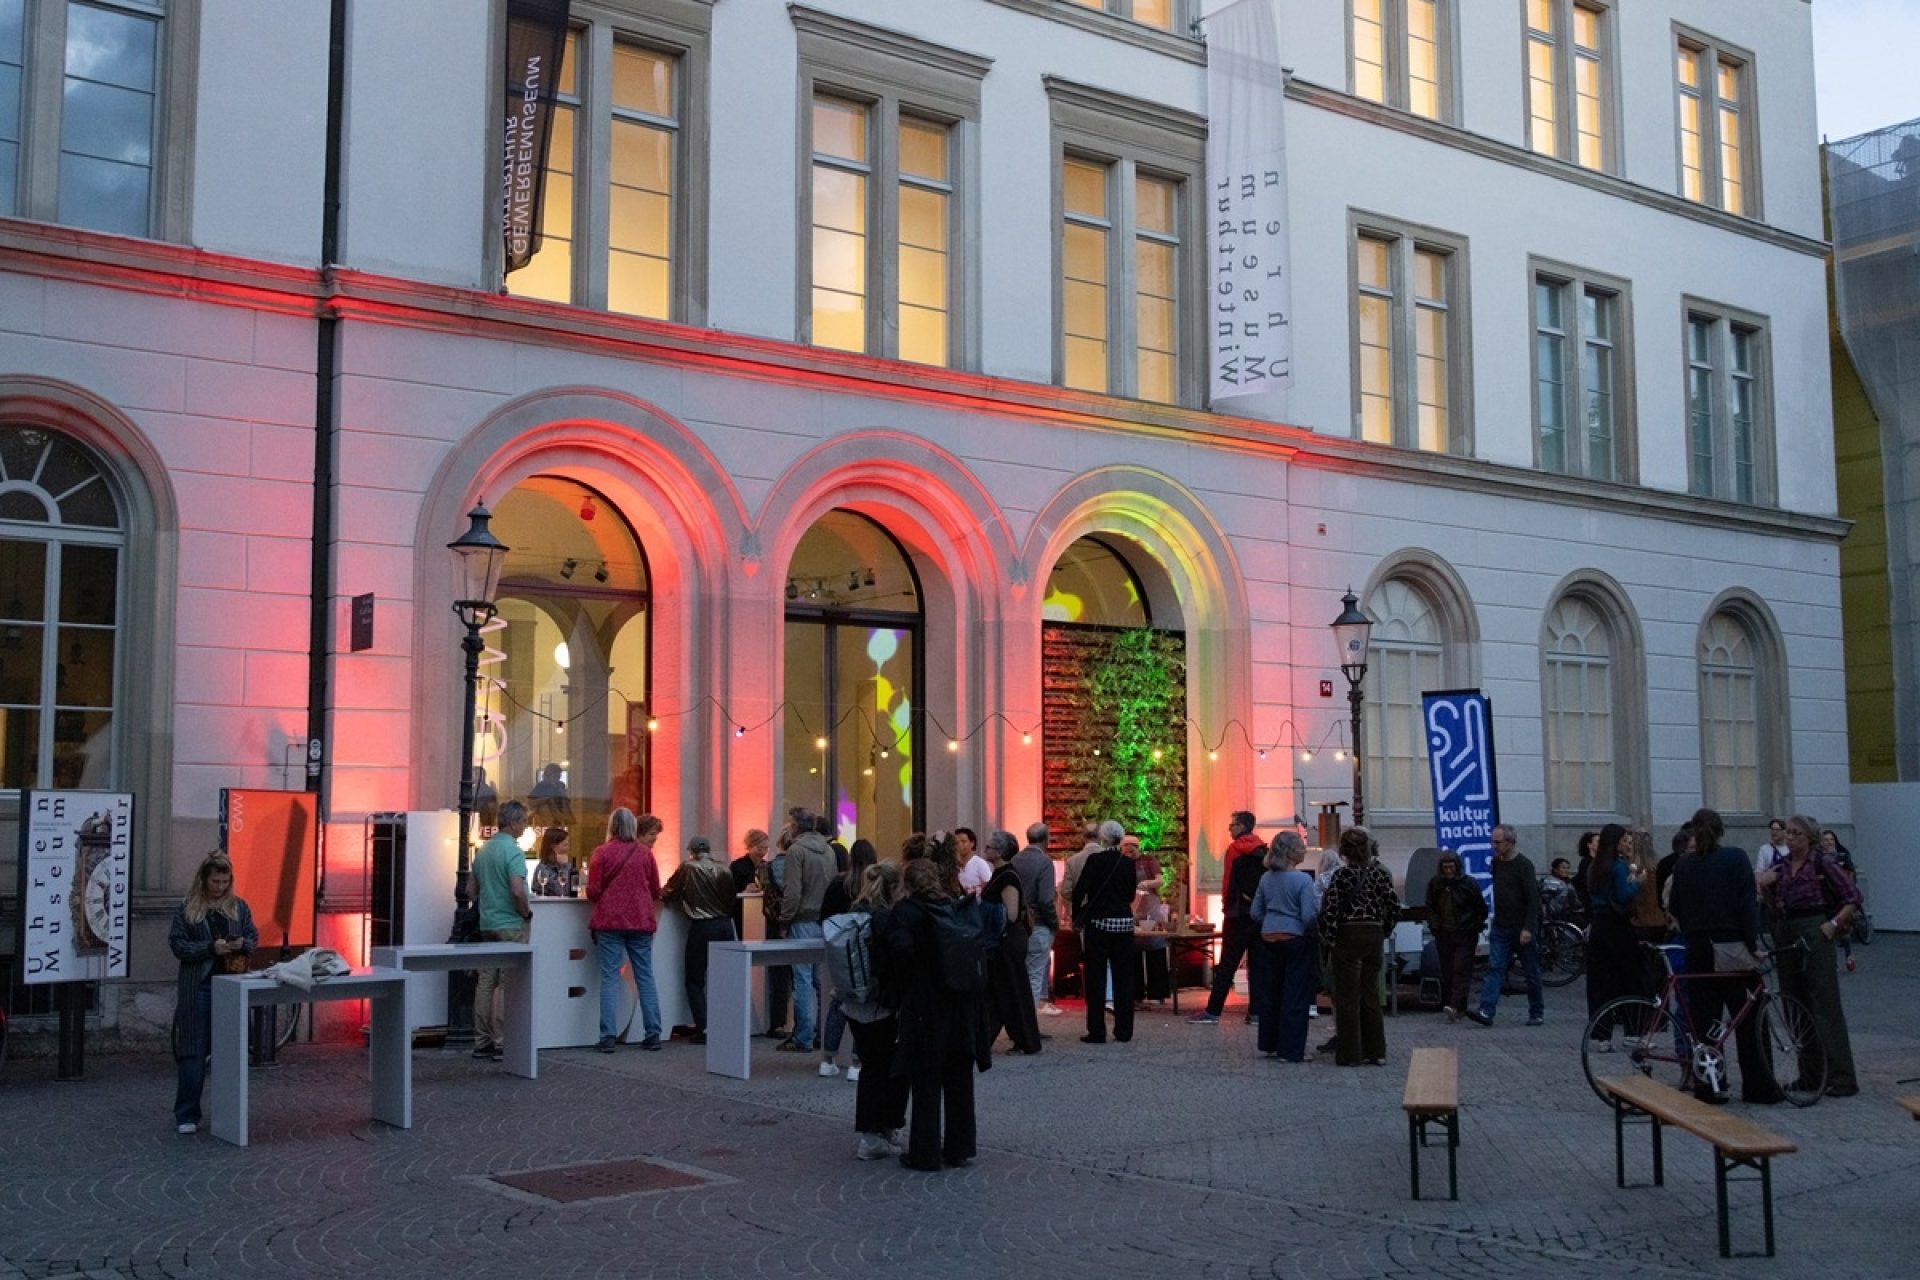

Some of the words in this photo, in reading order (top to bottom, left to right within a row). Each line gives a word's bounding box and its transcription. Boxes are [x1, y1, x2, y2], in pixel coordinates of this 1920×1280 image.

[28, 797, 49, 975] Uhren
[45, 797, 66, 973] Museum
[109, 799, 129, 969] Winterthur
[1439, 805, 1491, 823] kultur
[1440, 822, 1491, 838] nacht
